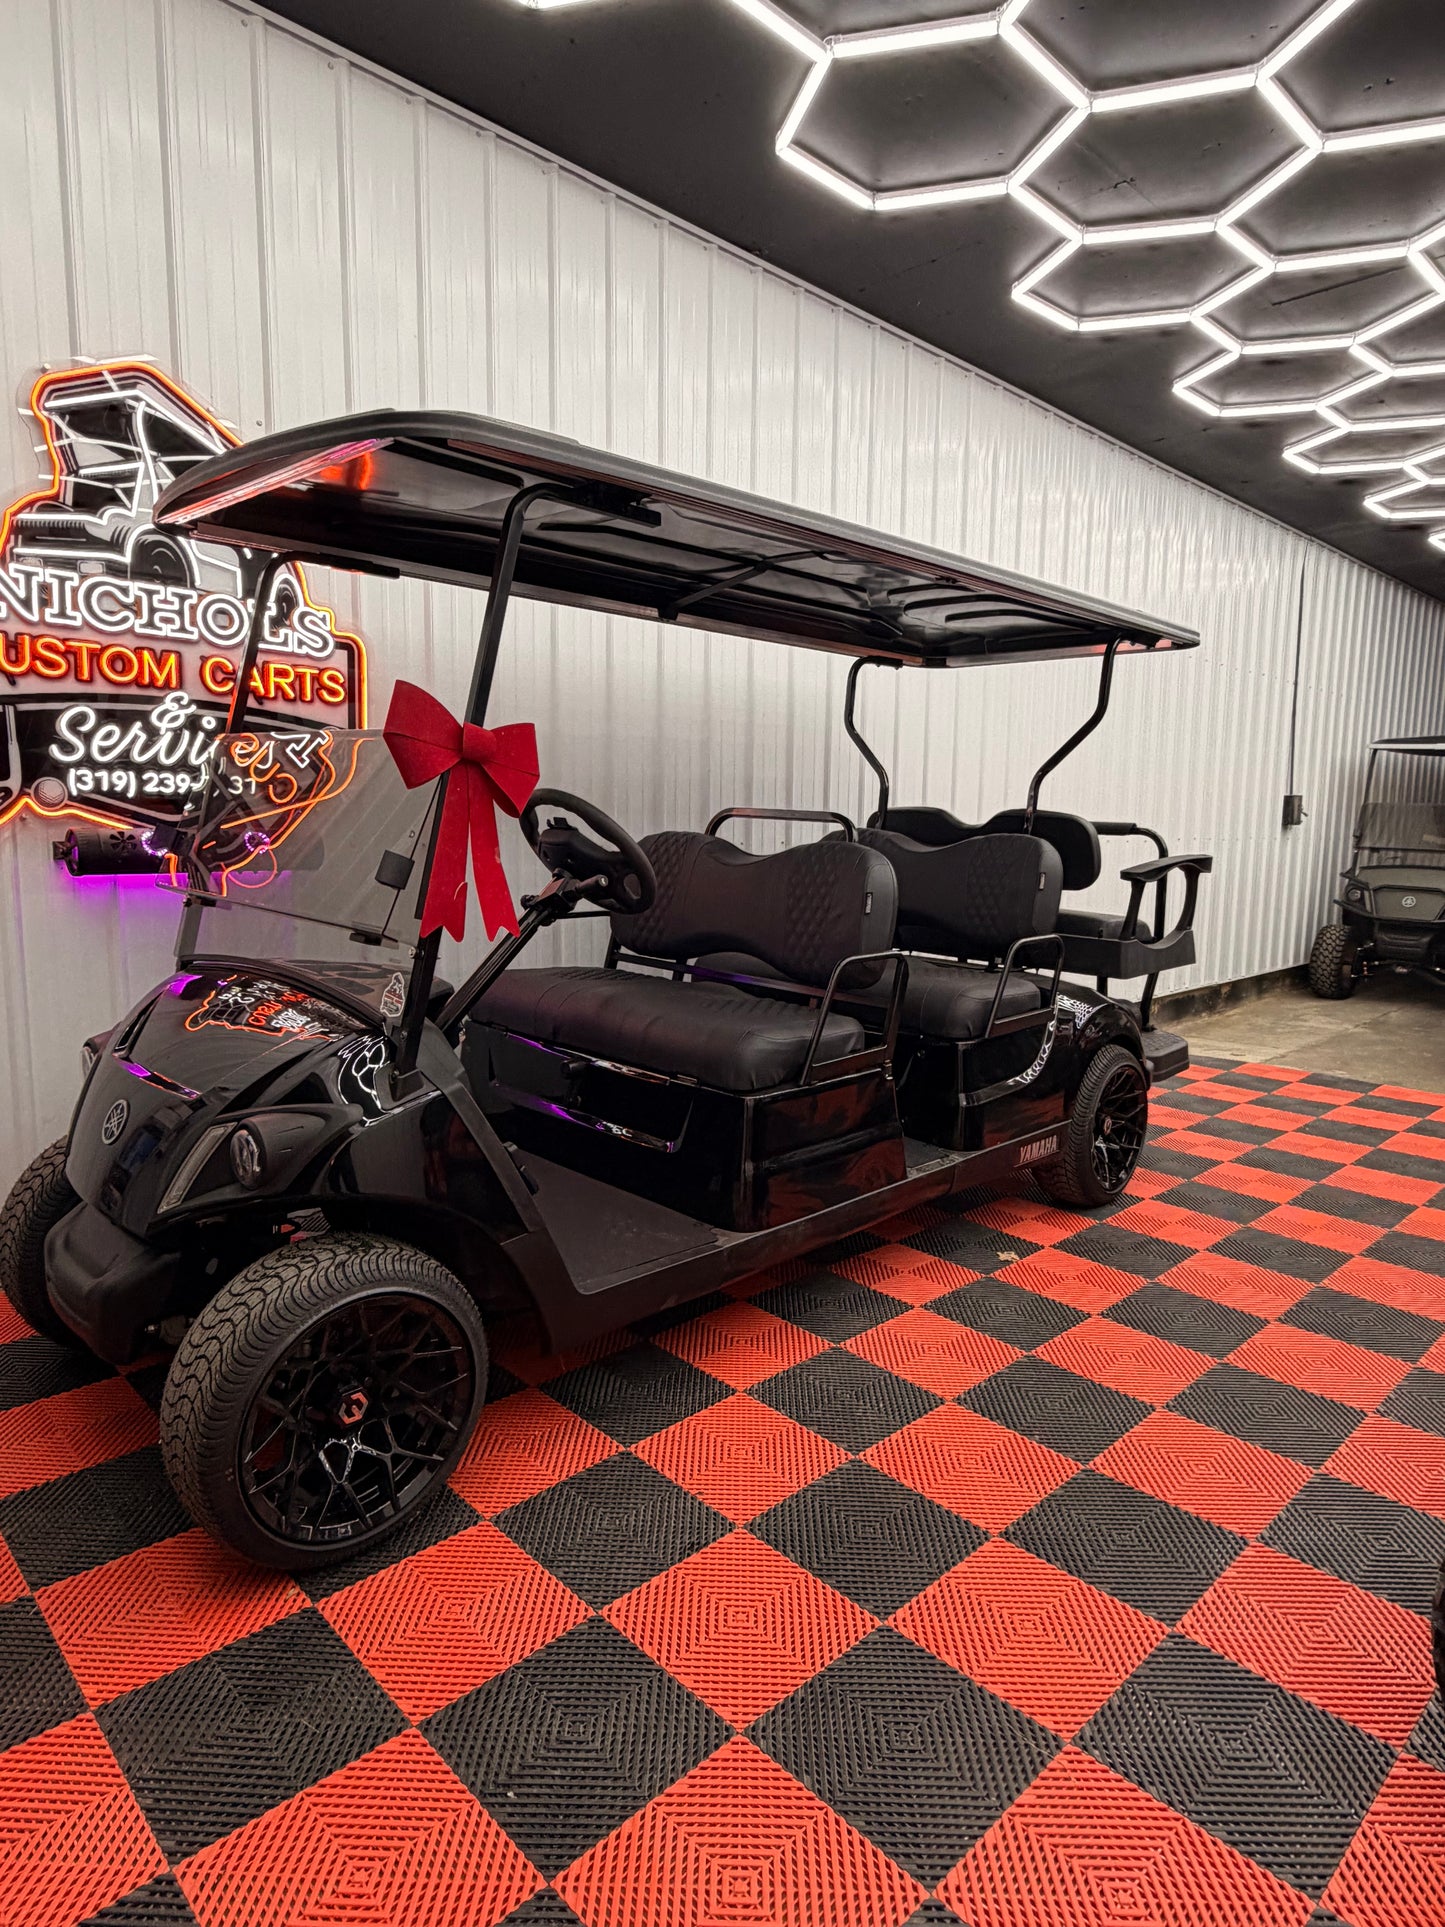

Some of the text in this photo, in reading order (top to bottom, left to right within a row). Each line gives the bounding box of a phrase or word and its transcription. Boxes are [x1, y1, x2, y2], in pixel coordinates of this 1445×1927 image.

[0, 562, 335, 659] NICHOLS
[201, 655, 348, 704] CARTS
[151, 691, 197, 735] &
[68, 767, 136, 798] (319)
[1019, 1134, 1057, 1164] YAMAHA
